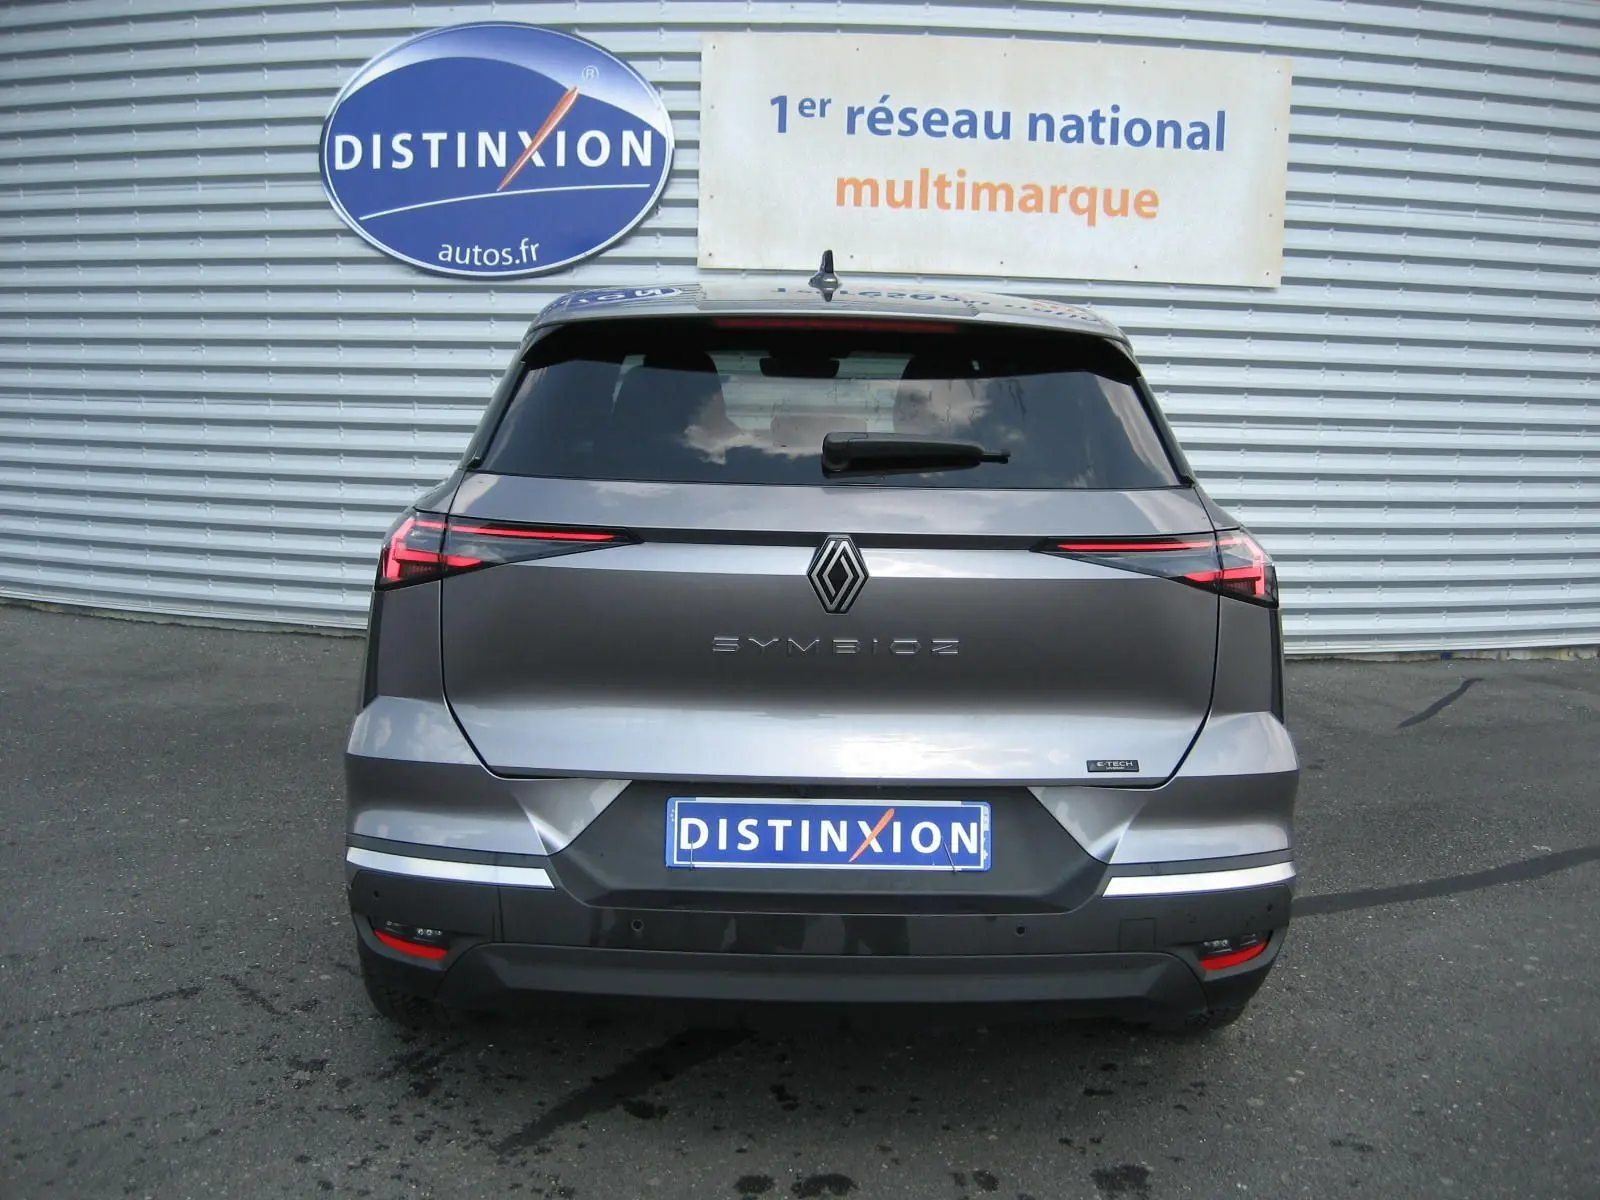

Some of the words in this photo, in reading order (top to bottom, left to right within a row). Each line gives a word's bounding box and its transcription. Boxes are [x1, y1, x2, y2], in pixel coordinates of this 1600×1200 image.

[846, 95, 1012, 141] réseau
[1028, 104, 1227, 152] national
[334, 129, 652, 170] DISTINXION
[835, 168, 1160, 227] multimarque
[437, 238, 540, 266] autos.fr
[711, 636, 961, 655] SYMBIOZ
[679, 816, 978, 854] DISTINXION
